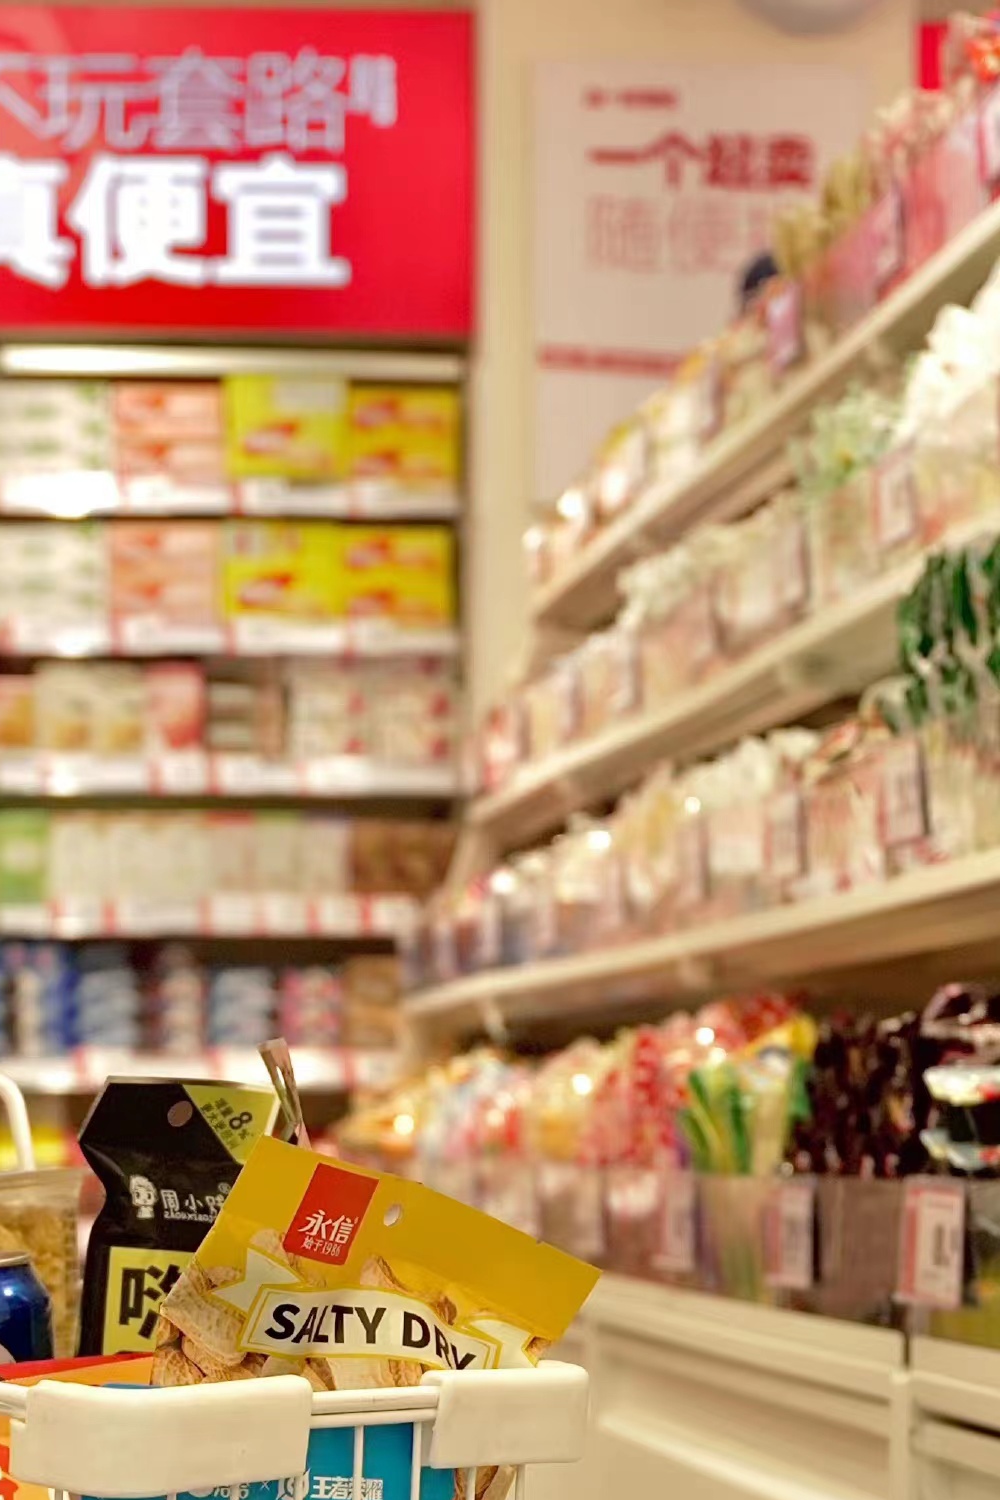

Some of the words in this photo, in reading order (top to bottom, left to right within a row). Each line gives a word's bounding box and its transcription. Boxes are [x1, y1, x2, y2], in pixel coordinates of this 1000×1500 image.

[297, 1209, 354, 1244] 永信
[301, 1236, 342, 1257] 始于1986
[265, 1304, 386, 1344] SALTY
[402, 1311, 476, 1370] DRY
